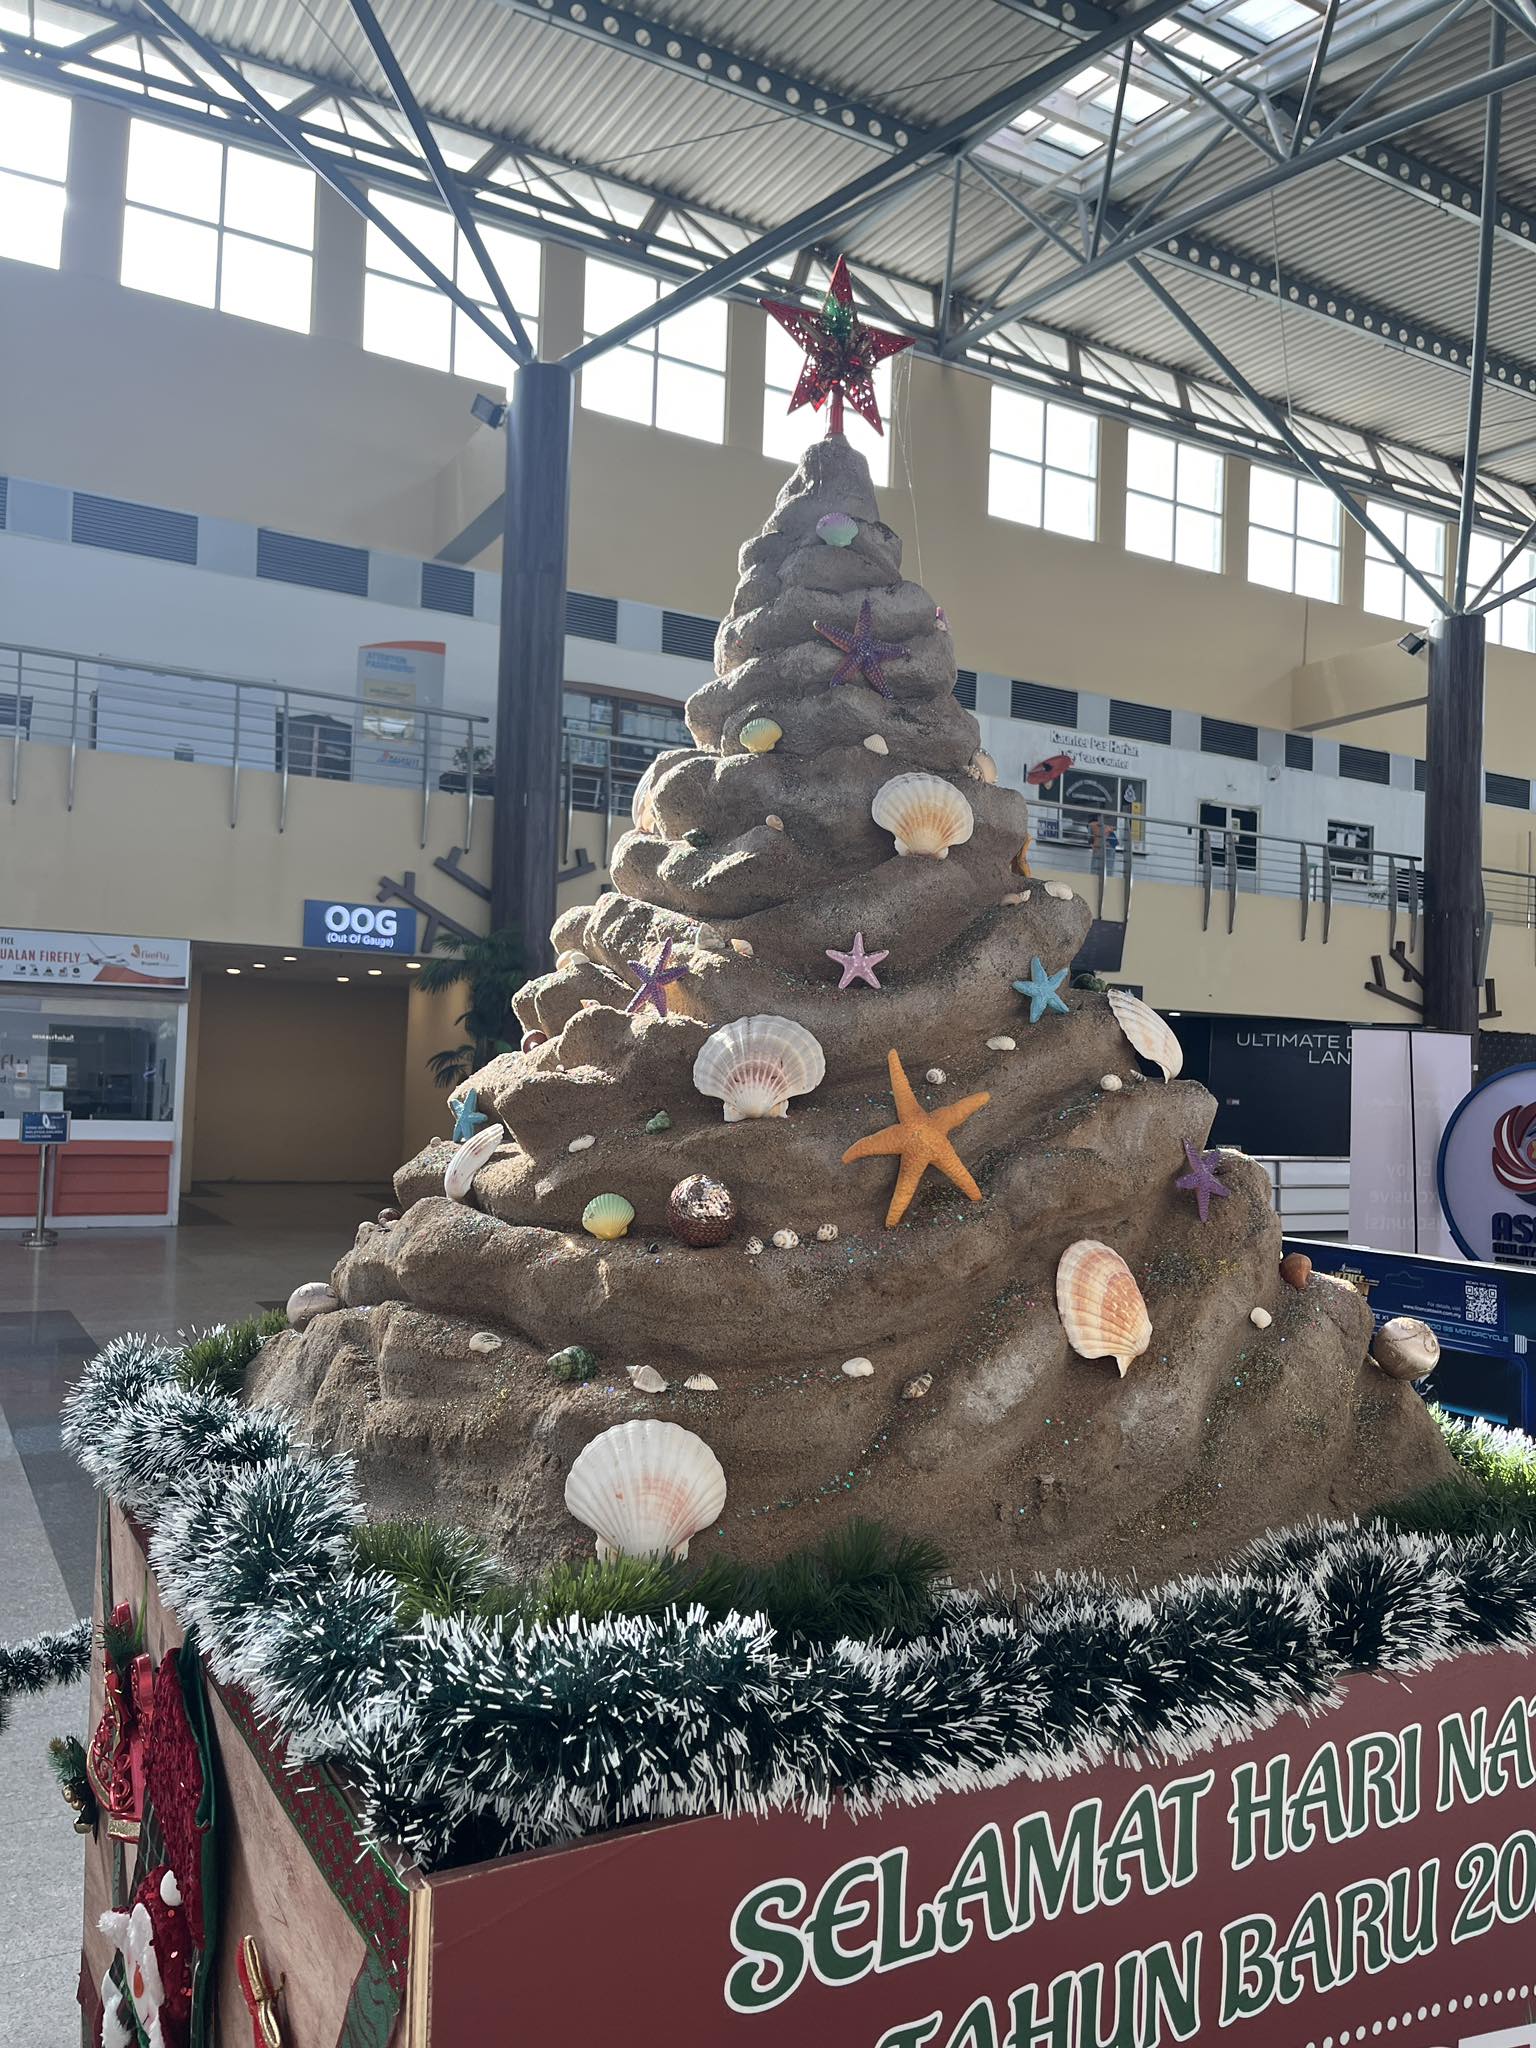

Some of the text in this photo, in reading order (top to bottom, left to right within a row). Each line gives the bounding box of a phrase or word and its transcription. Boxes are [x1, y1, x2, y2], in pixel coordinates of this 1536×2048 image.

[324, 905, 398, 936] OOG
[326, 931, 395, 948] (Out Of Gauge)
[39, 950, 81, 964] FIREFLY
[1236, 1032, 1340, 1049] ULTIMATE
[1492, 1212, 1536, 1244] AS
[1455, 1328, 1509, 1343] MOTORCYCLE
[723, 1695, 1536, 2014] SELAMAT HARI NA
[875, 1829, 1536, 2048] HUN BARU 20
